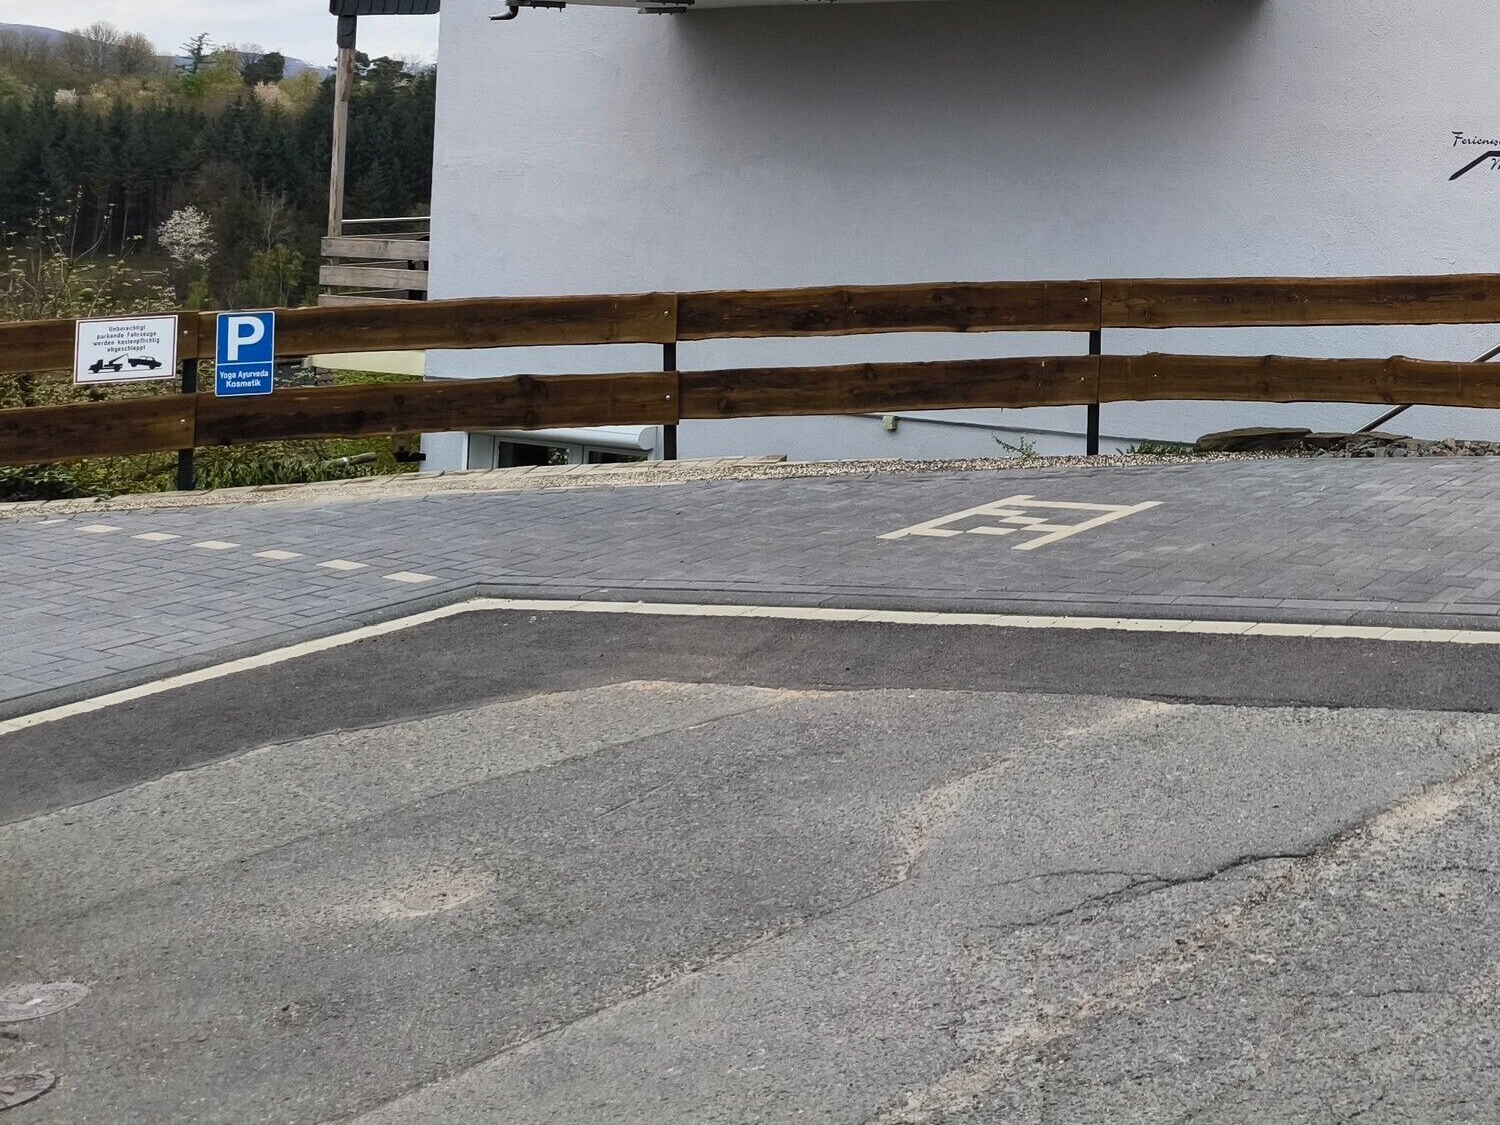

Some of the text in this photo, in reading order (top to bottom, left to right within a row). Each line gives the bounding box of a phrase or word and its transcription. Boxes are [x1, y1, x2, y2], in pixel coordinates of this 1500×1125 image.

[227, 316, 265, 361] P
[219, 369, 269, 380] Yoga Ayurveda
[225, 378, 262, 388] Kosmetik
